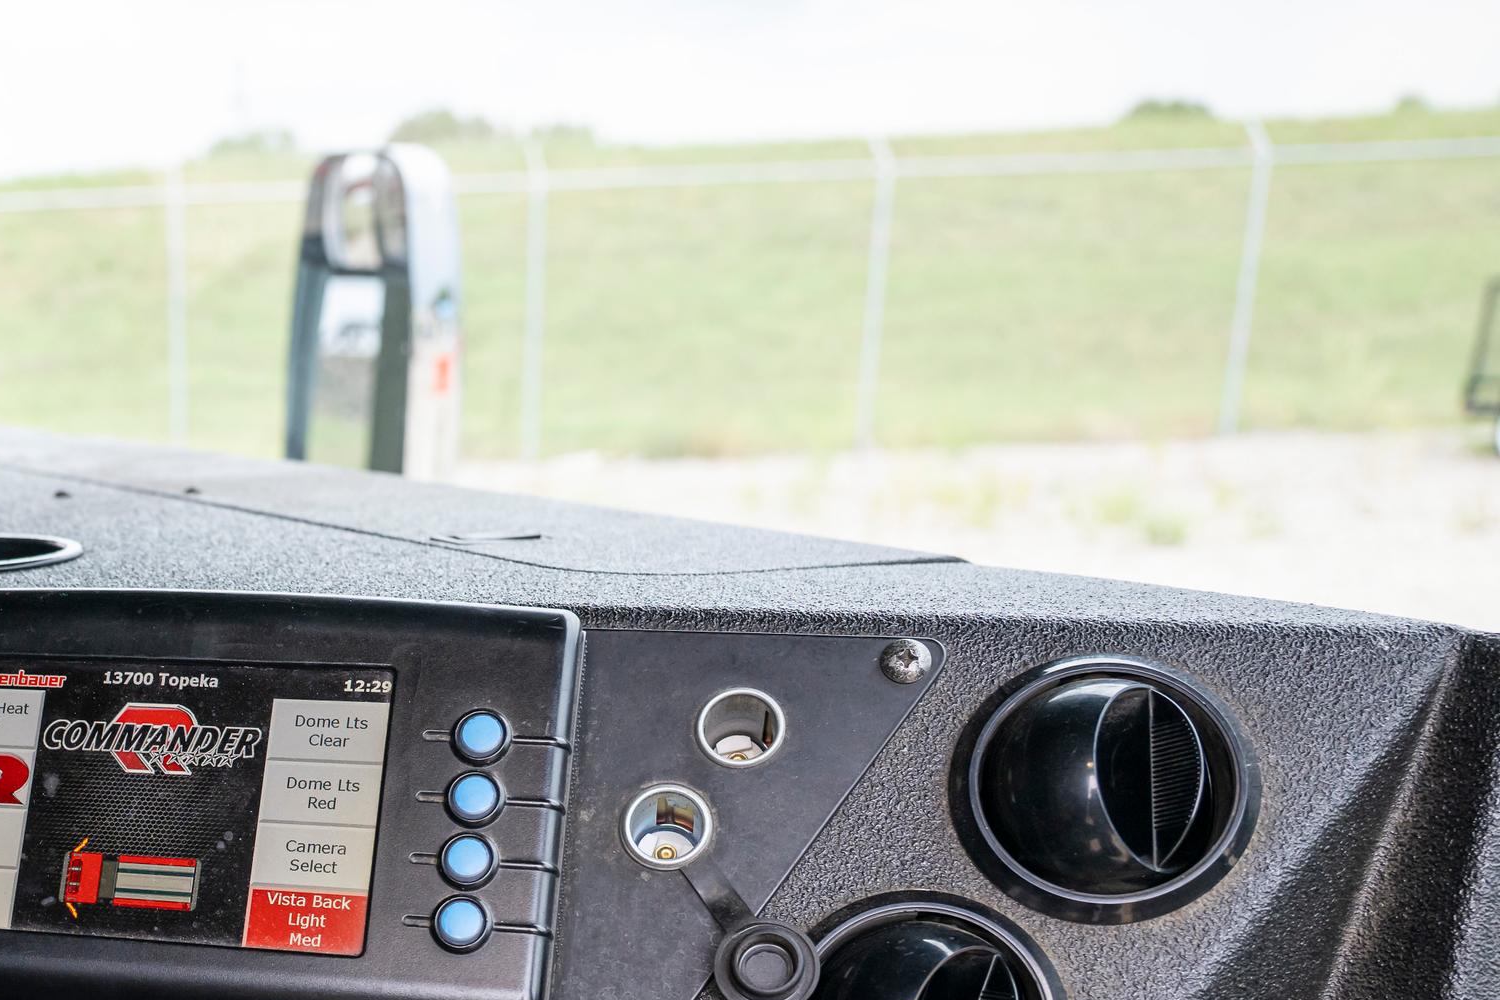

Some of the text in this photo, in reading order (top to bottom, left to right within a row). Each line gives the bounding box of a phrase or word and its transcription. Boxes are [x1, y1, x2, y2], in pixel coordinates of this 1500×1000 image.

[103, 671, 219, 689] 13700 Topeka
[344, 680, 392, 693] 12:29
[295, 714, 369, 729] Dome Lts
[42, 718, 262, 758] COMMANDER
[309, 734, 350, 747] Clear
[286, 776, 360, 792] Dome Lts
[308, 796, 337, 810] Red
[286, 840, 347, 855] Camera
[289, 859, 338, 873] Select
[267, 892, 351, 910] Vista Back
[288, 913, 326, 929] Light
[289, 932, 322, 947] Med
